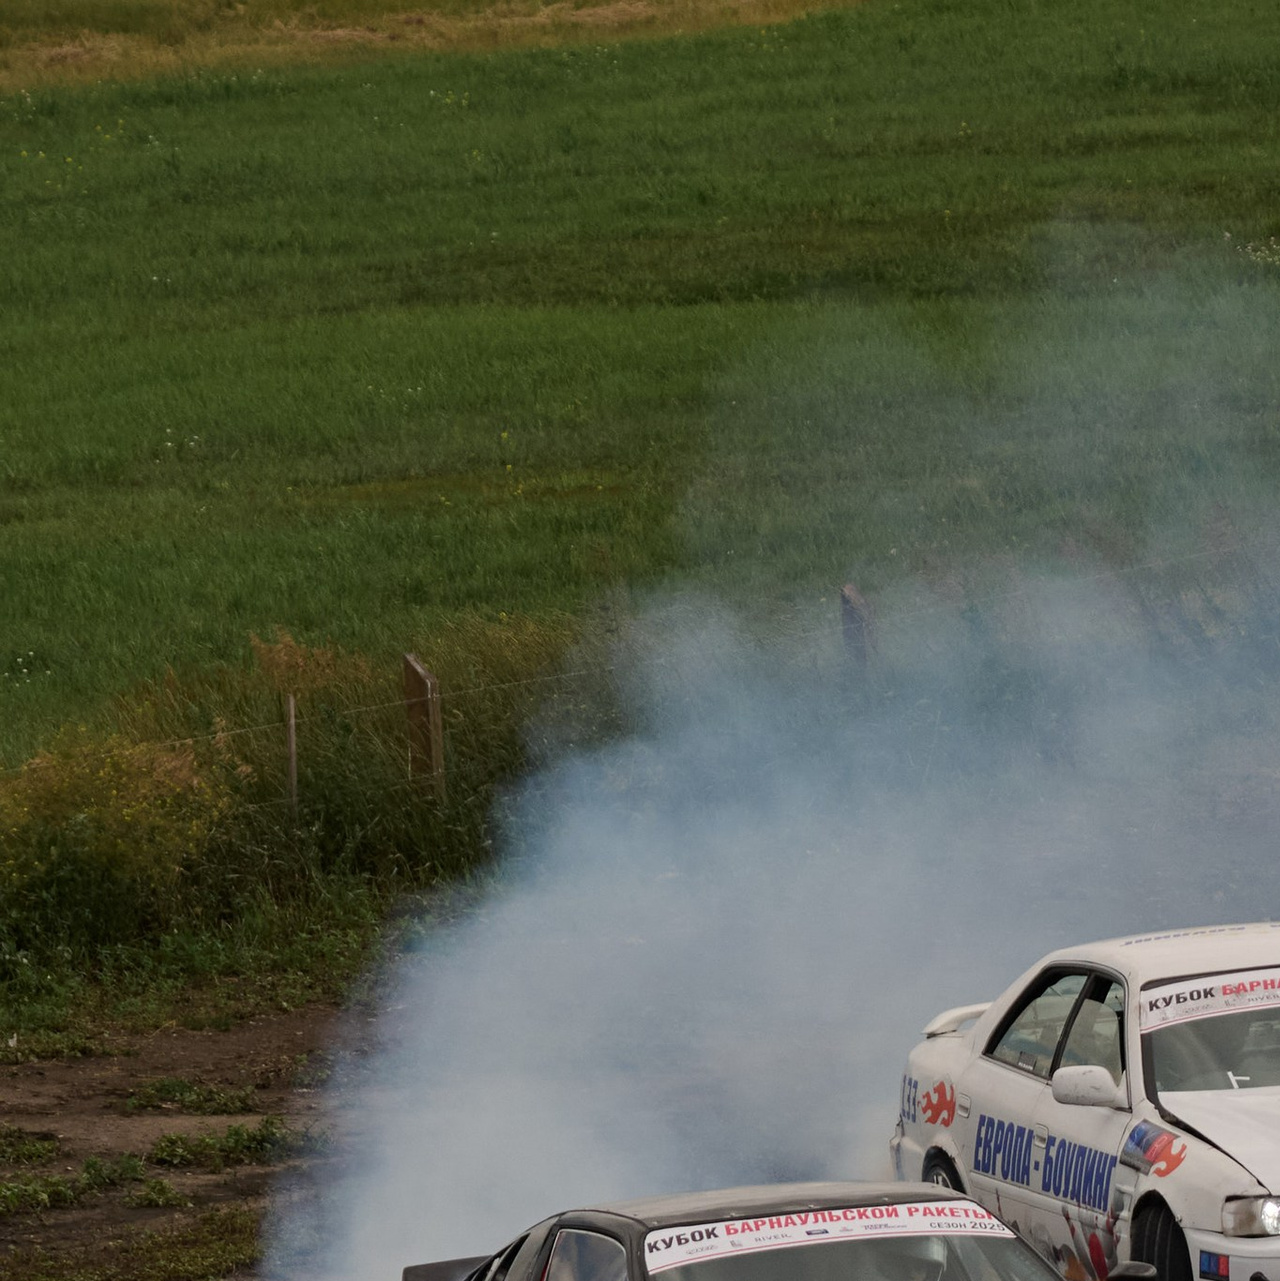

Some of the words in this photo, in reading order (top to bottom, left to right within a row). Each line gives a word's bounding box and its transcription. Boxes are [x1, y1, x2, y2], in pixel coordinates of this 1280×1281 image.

[1148, 985, 1216, 1012] КУБОК
[973, 1114, 1036, 1187] ЕВРОПА
[1041, 1134, 1118, 1213] БОУЛИНГ
[646, 1226, 720, 1253] КУБОК
[724, 1205, 899, 1236] БАРНАУЛЬСКОЙ
[907, 1206, 995, 1220] РАКЕТЫ
[970, 1220, 1007, 1232] 2025
